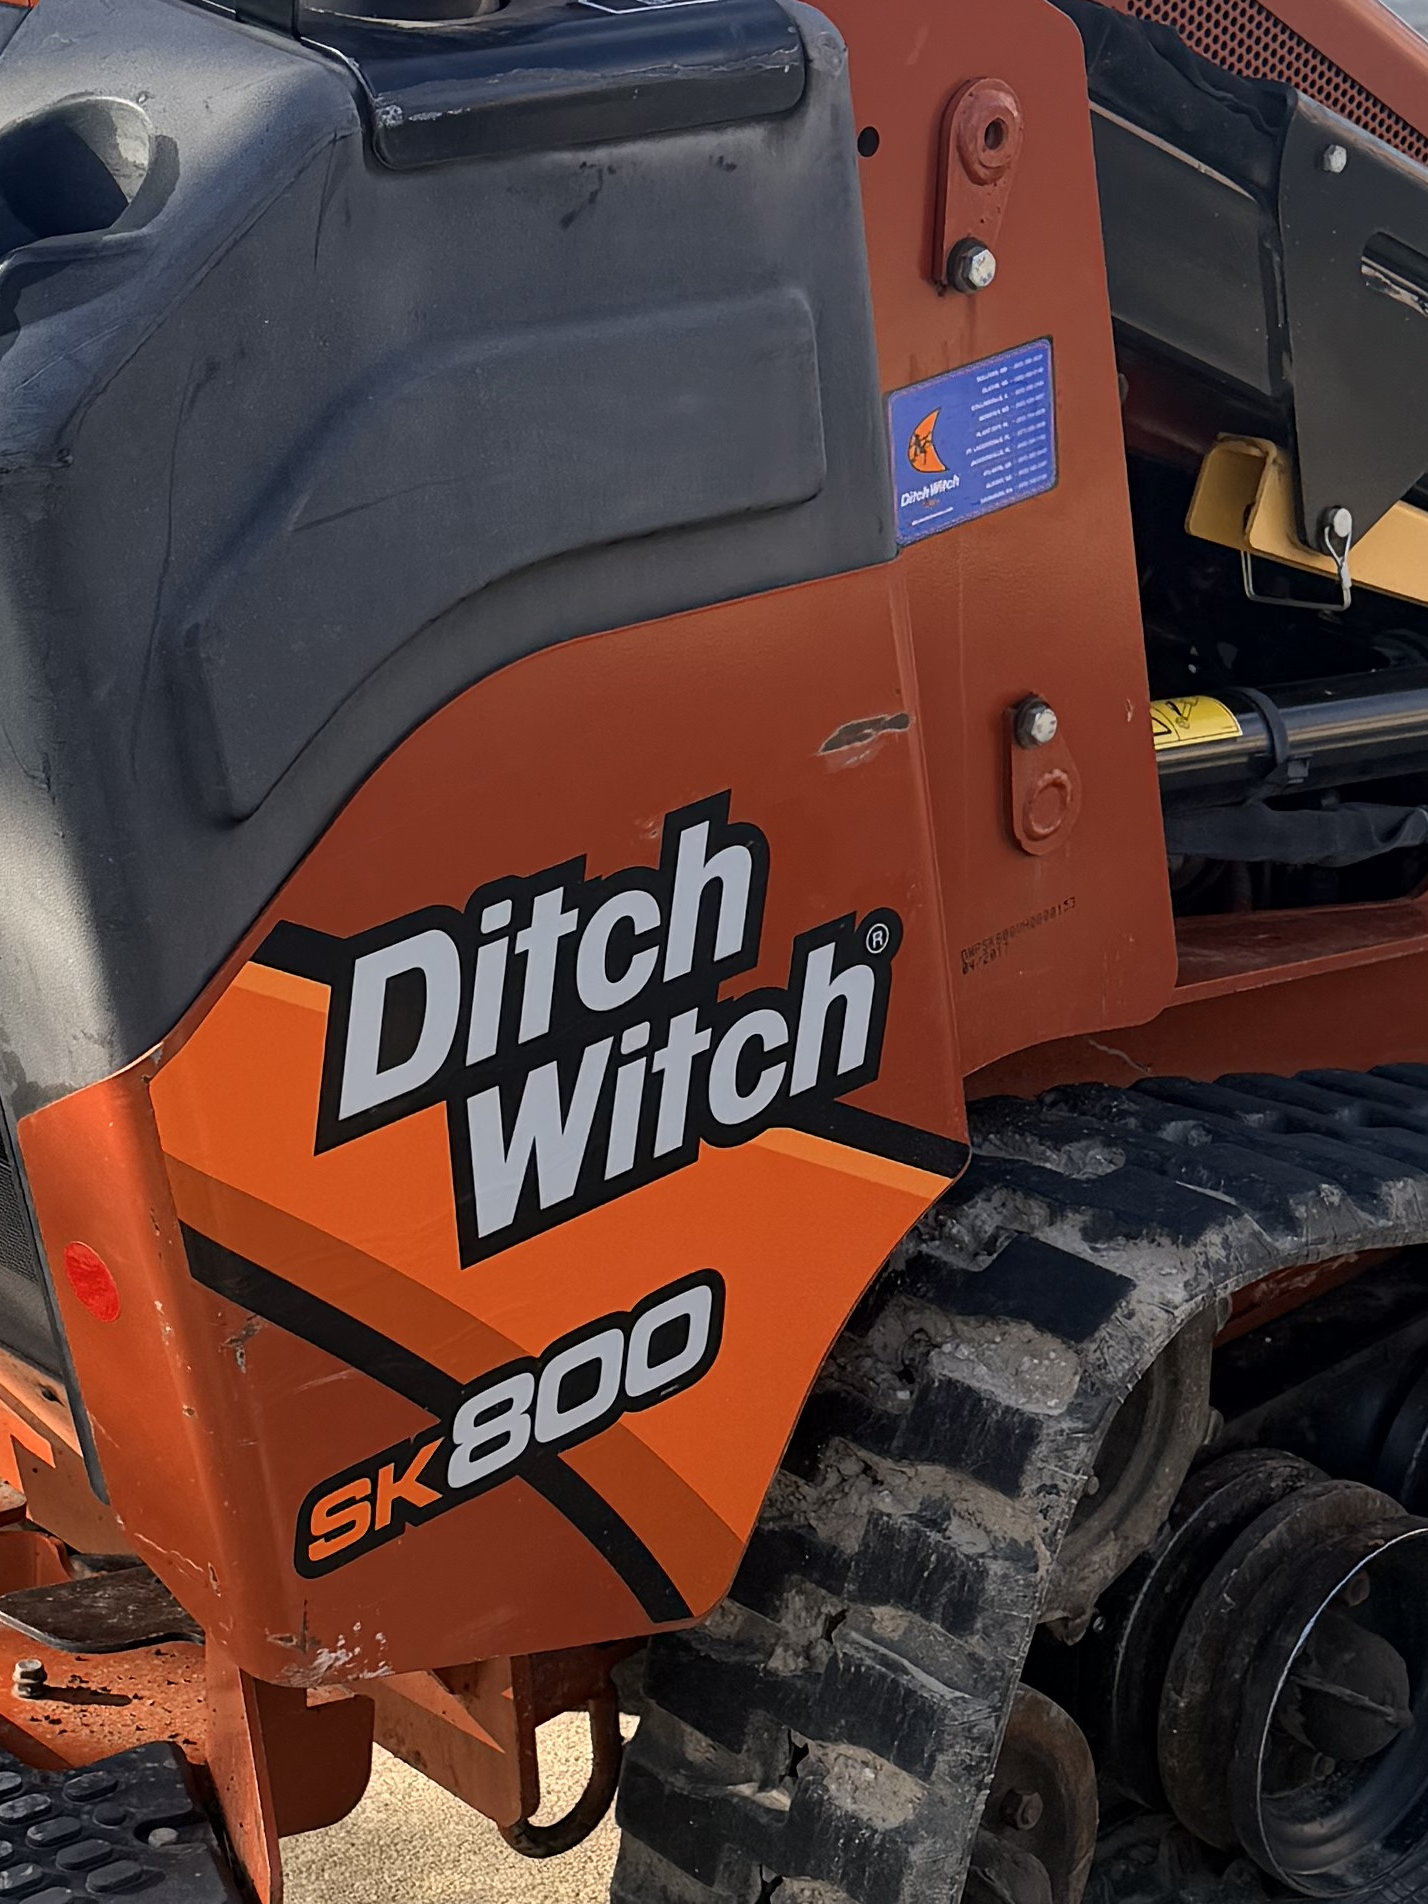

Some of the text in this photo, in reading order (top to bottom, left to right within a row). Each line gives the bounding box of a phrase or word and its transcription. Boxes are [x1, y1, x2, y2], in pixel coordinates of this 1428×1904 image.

[901, 486, 930, 508] Ditch
[929, 473, 961, 497] Witch
[338, 819, 753, 1123] Ditch
[467, 940, 877, 1239] Witch
[308, 1281, 714, 1564] SK800
